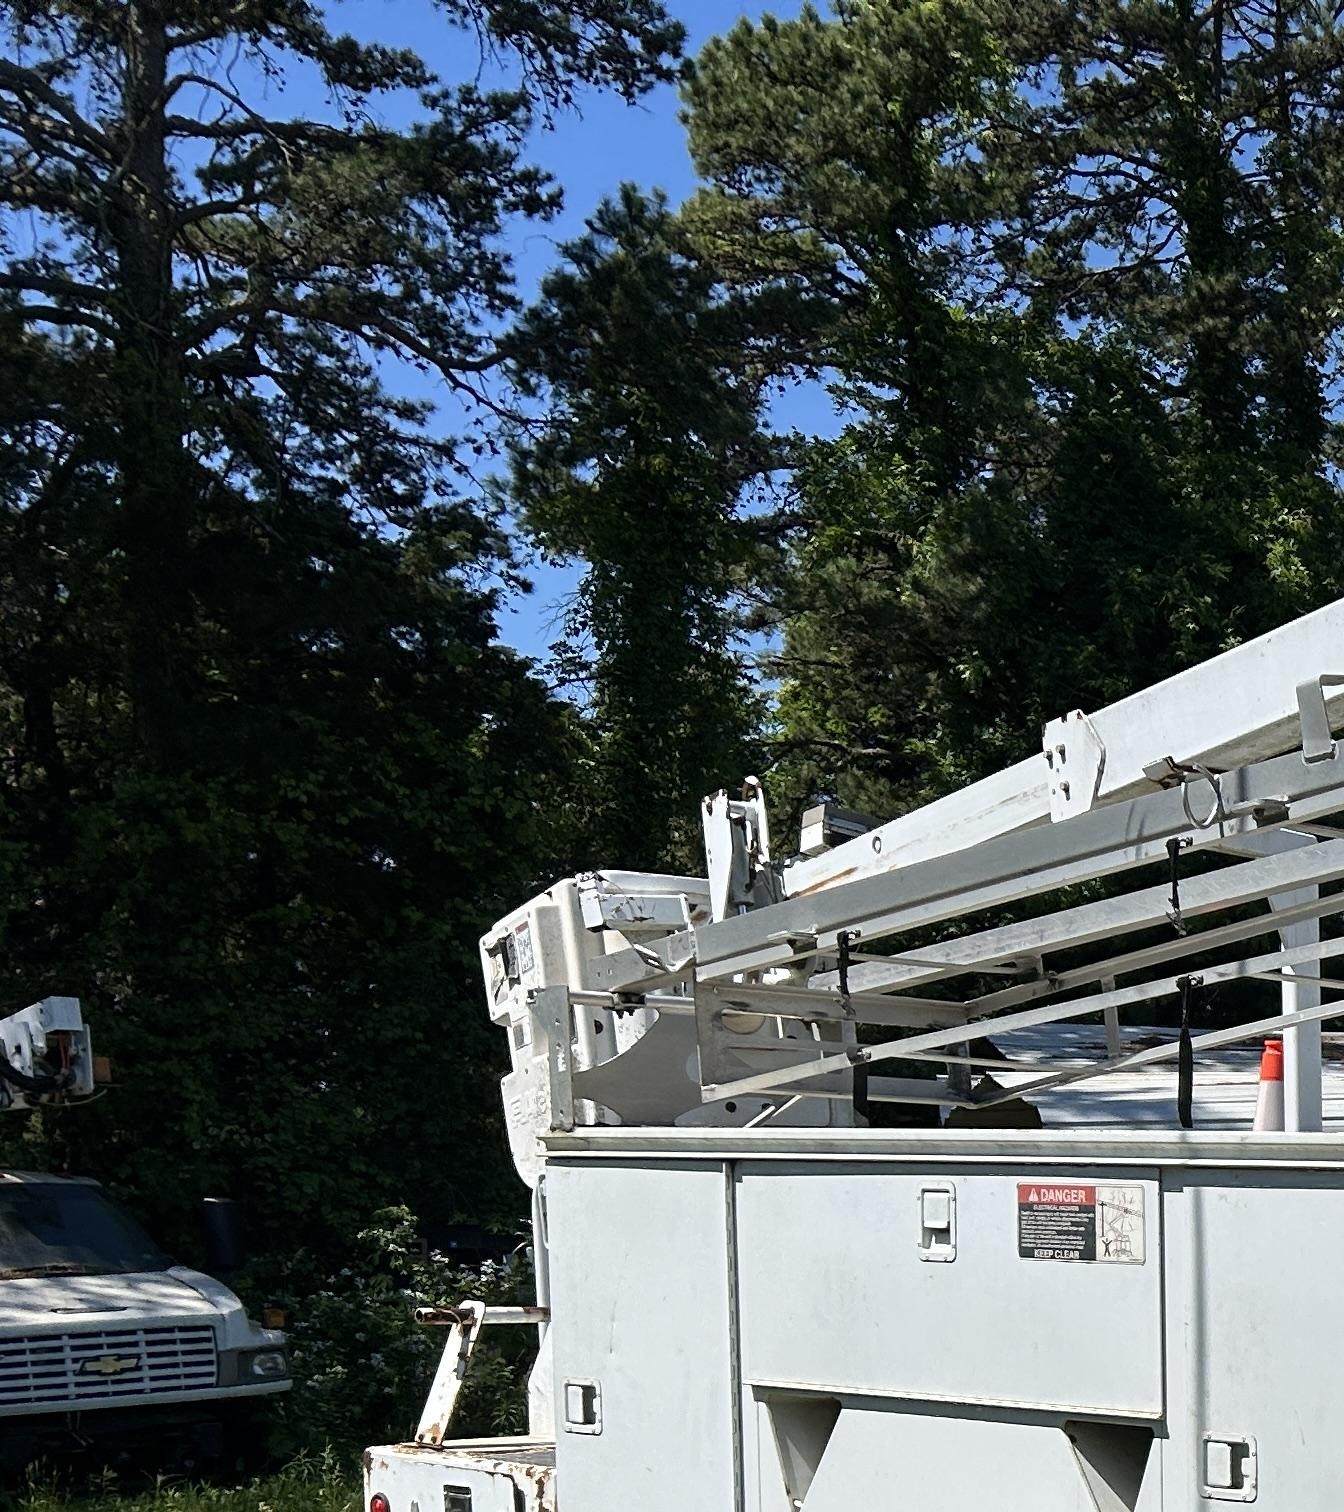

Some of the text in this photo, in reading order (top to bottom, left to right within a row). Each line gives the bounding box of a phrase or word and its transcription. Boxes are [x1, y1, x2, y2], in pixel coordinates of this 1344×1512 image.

[1041, 1188, 1086, 1203] DANGER
[1034, 1249, 1080, 1260] KEEP CLEAR
